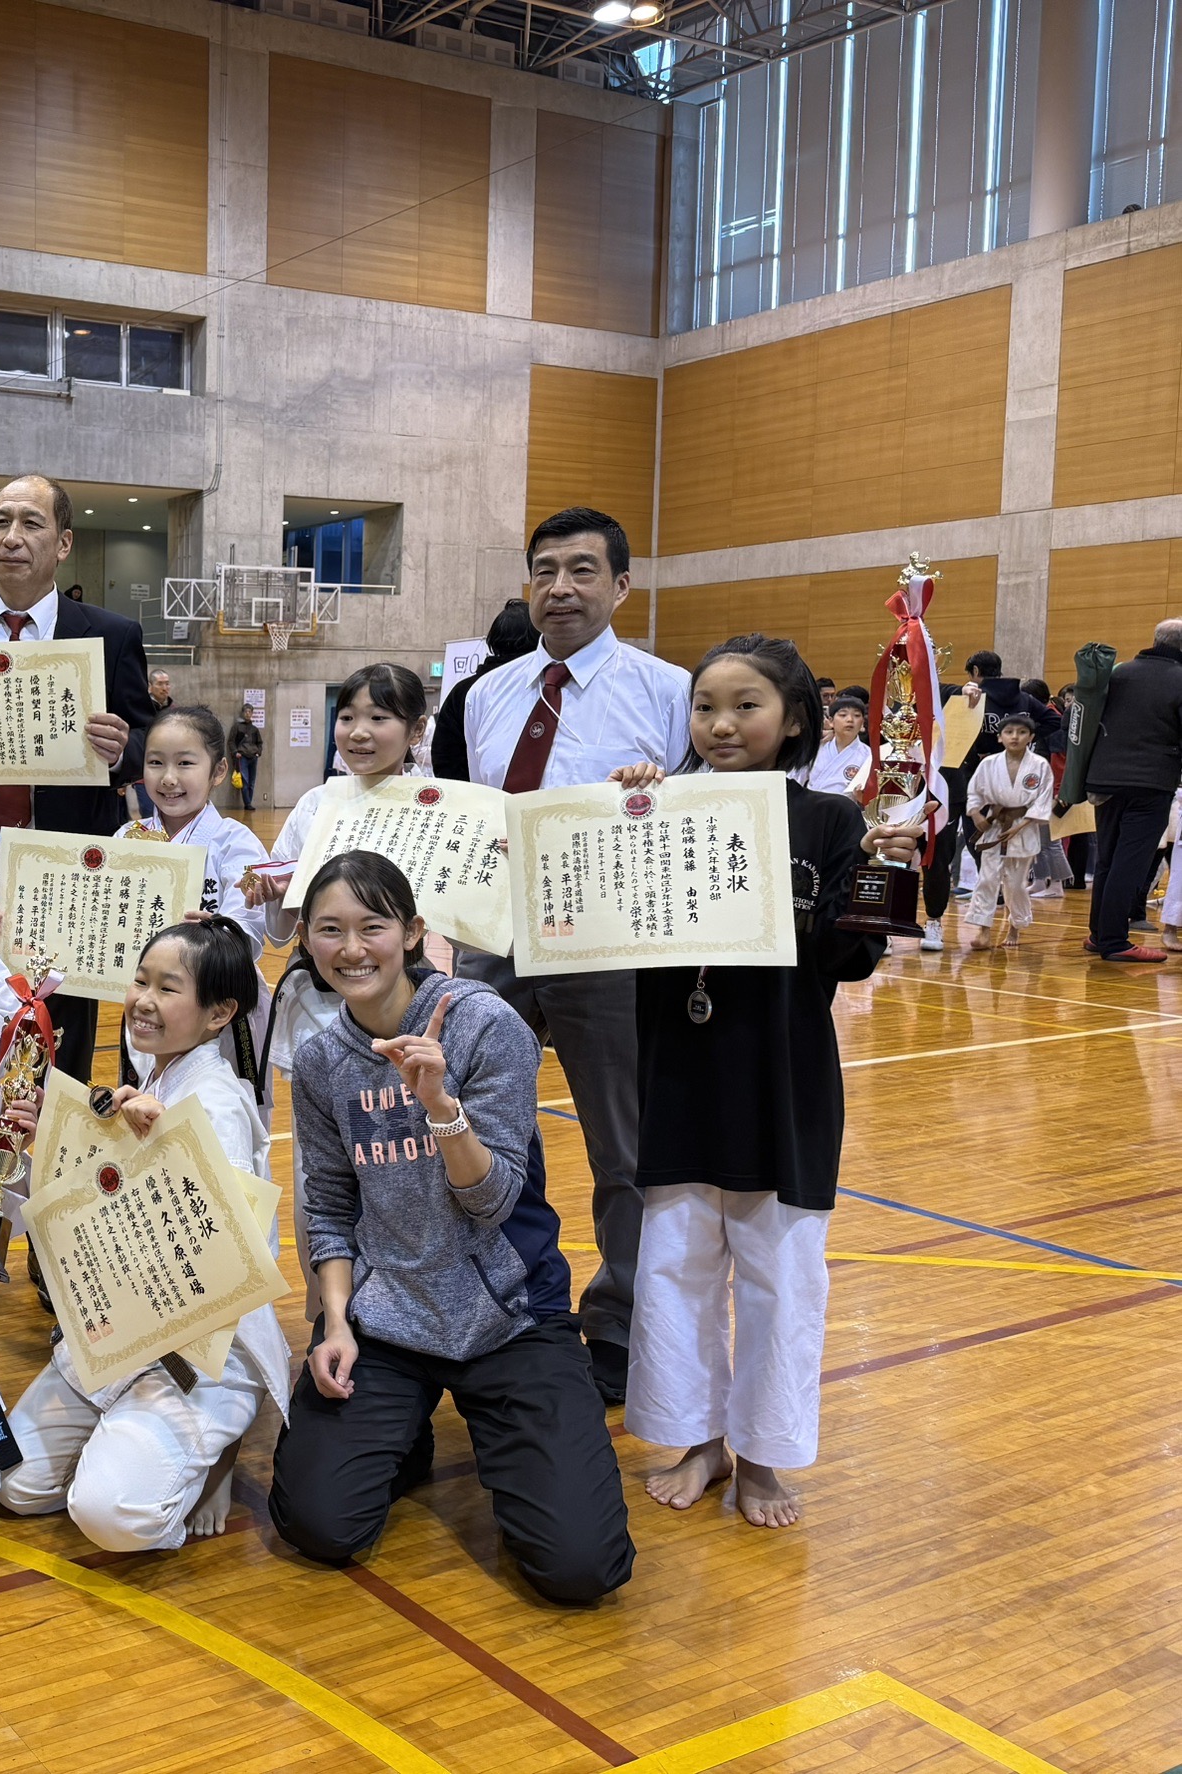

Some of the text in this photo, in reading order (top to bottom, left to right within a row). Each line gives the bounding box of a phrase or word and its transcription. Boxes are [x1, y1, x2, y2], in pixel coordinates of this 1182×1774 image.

[61, 688, 76, 734] 表彰状
[474, 838, 501, 886] 表彰状
[561, 852, 569, 868] 会長
[726, 833, 749, 893] 表彰状
[360, 1083, 414, 1113] UNDE
[355, 1134, 437, 1165] ARMOU
[182, 1177, 219, 1239] 表彰状
